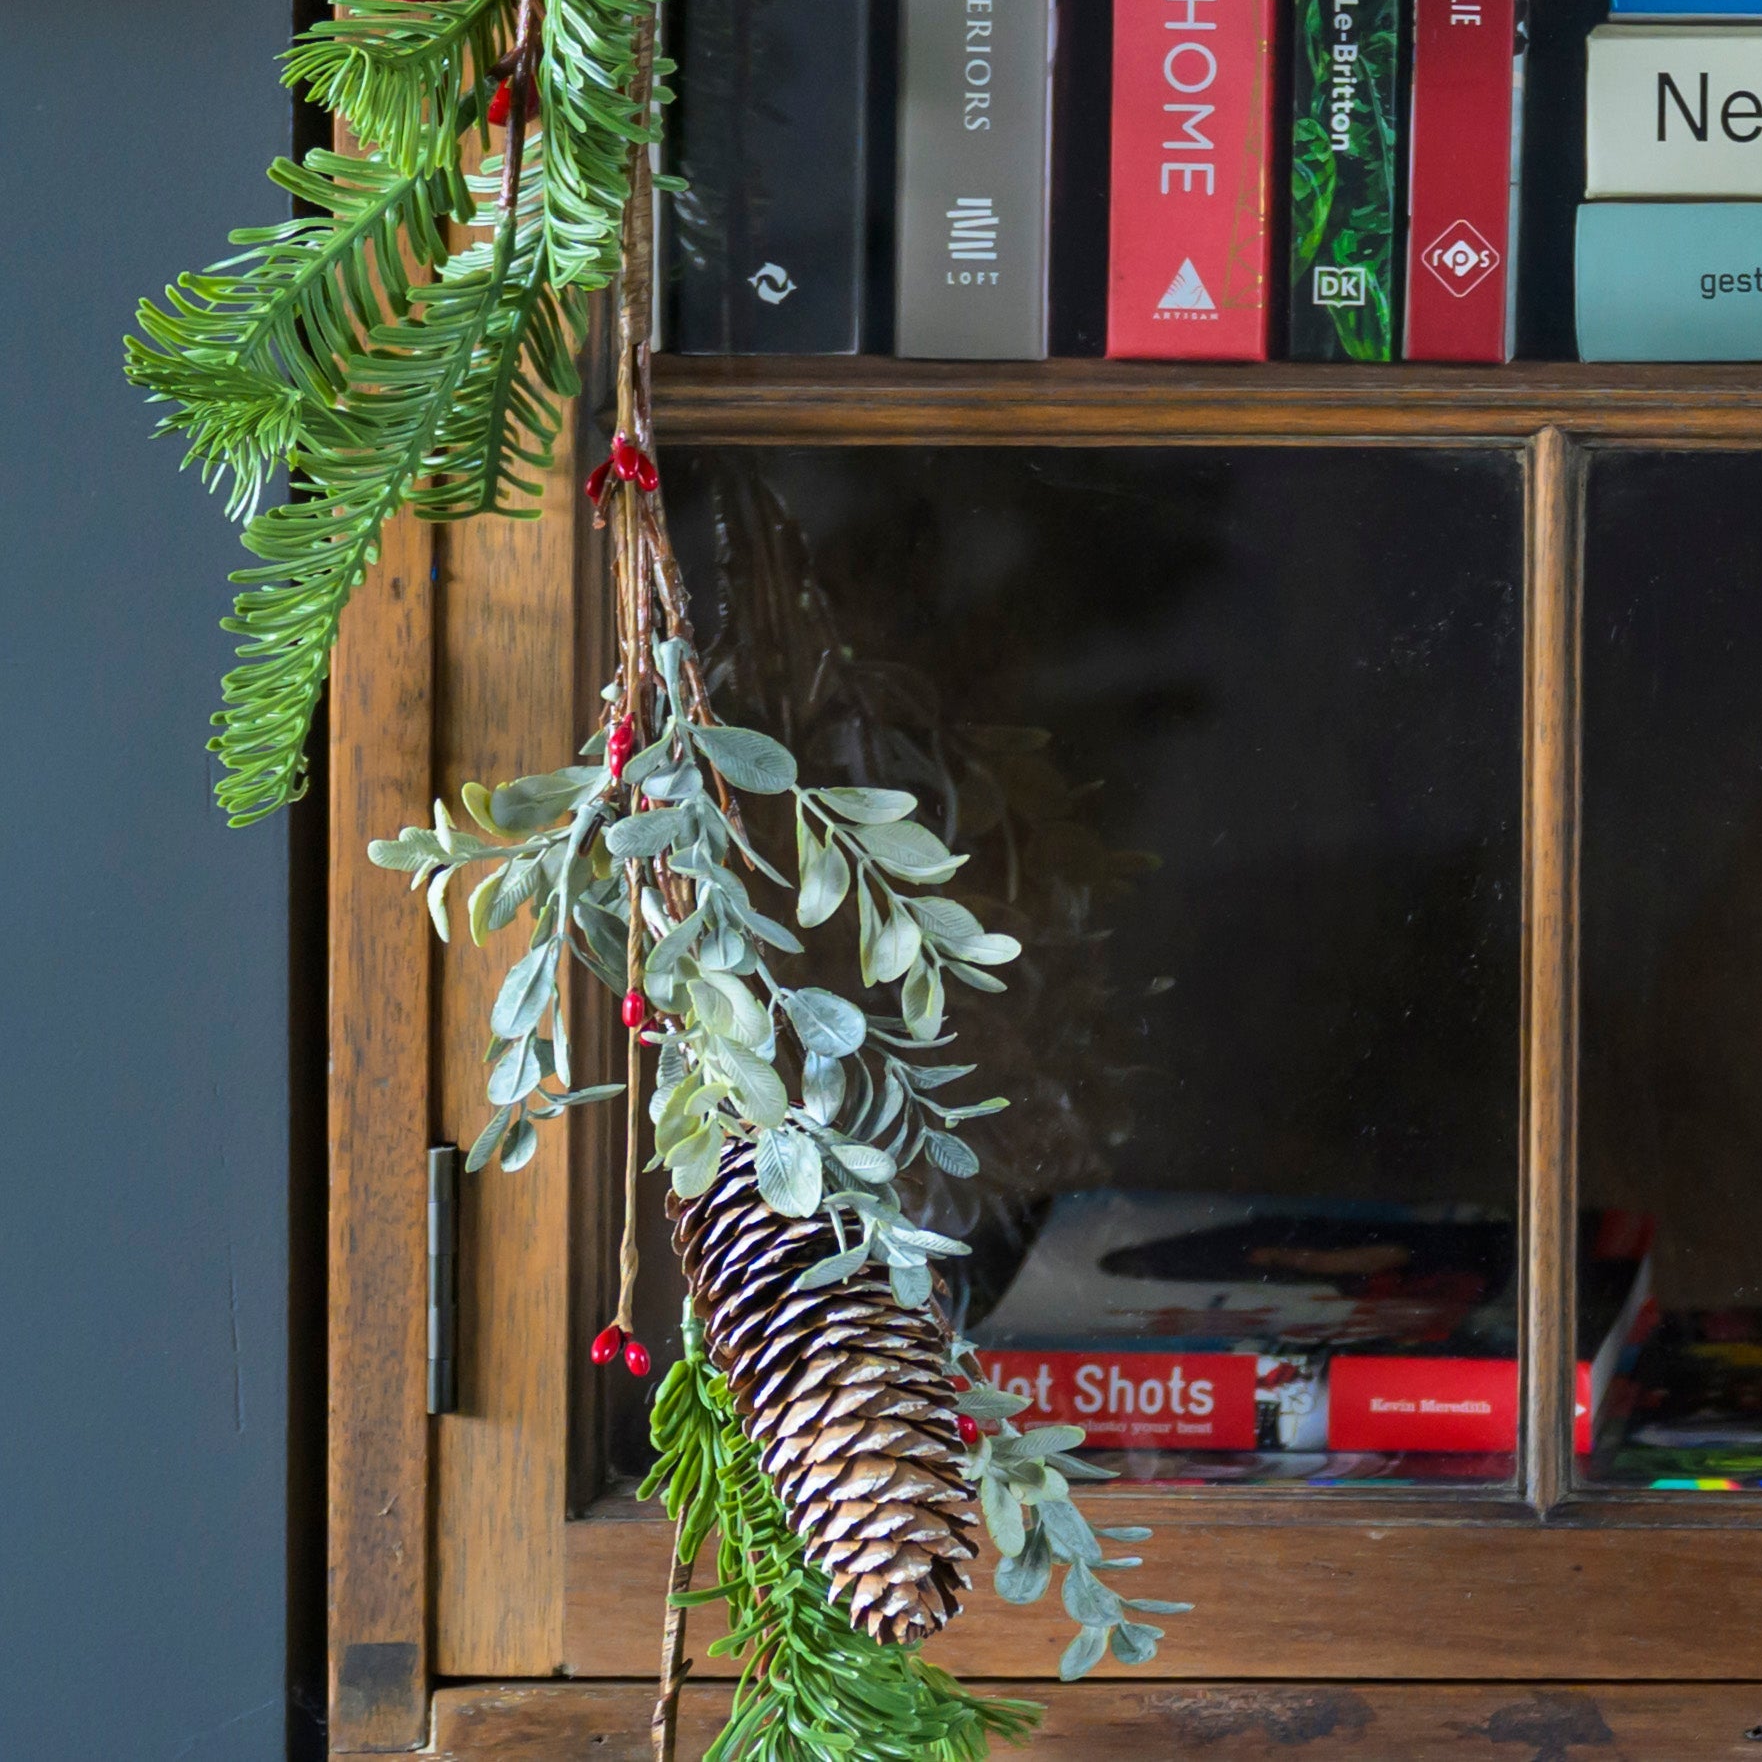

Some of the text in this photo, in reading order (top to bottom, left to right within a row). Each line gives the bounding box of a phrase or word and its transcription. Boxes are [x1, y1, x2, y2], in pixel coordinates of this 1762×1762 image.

[946, 271, 1000, 286] LOFT
[1319, 266, 1359, 298] DK
[1073, 1364, 1215, 1416] Shots
[1369, 1398, 1492, 1415] Kevin Meredith
